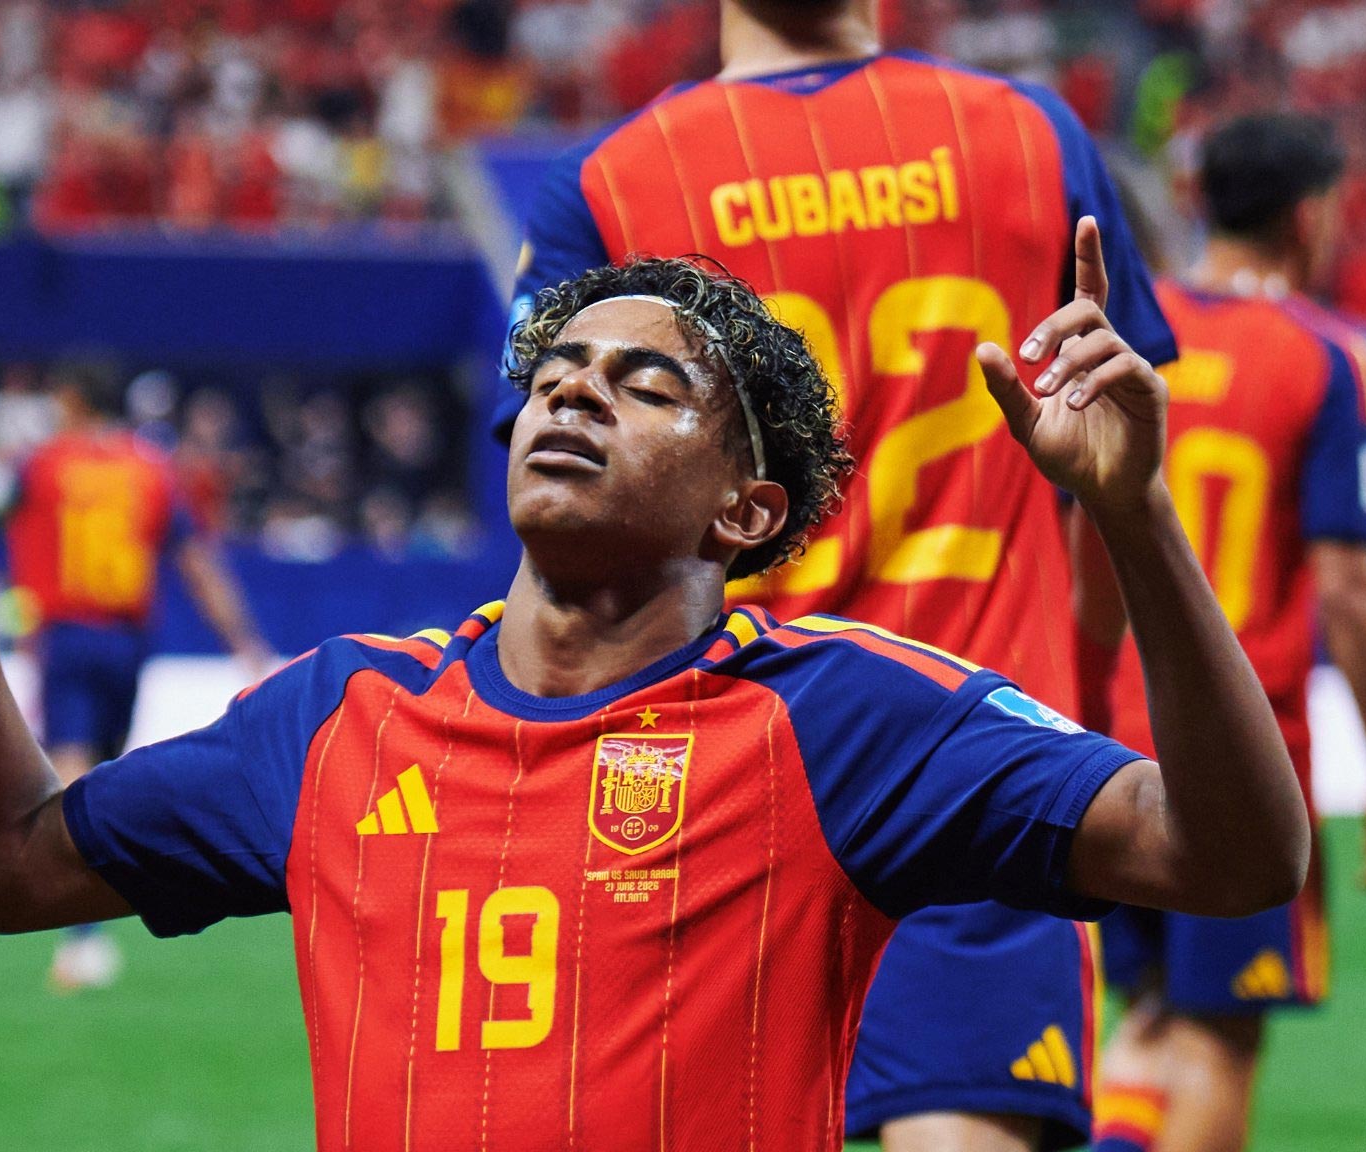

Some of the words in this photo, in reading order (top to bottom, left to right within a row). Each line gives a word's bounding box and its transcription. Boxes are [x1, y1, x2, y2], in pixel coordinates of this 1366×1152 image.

[710, 147, 958, 247] CUBARSÍ
[724, 275, 1013, 597] 2
[586, 871, 609, 881] SPAIN
[624, 870, 648, 880] SAUDI
[650, 868, 679, 879] ARABIA
[605, 882, 614, 892] 21
[616, 881, 635, 891] JUNE
[637, 881, 659, 891] 2026
[614, 892, 649, 903] ATLANTA
[436, 886, 560, 1051] 19
